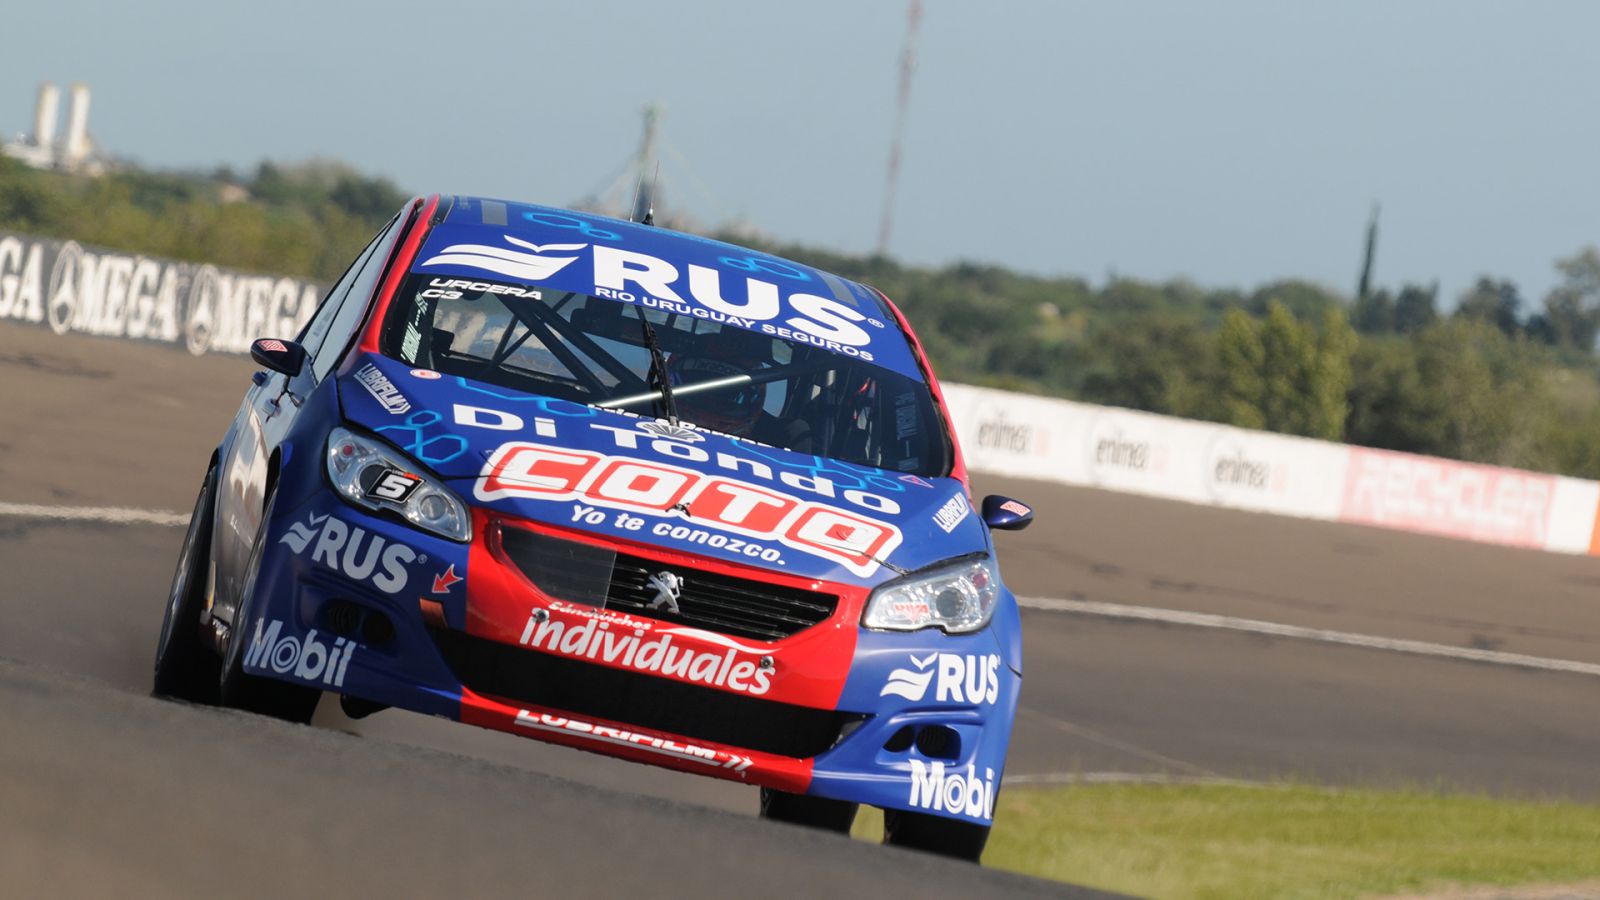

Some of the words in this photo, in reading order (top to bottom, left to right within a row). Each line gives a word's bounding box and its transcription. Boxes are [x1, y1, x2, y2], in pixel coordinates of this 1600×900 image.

[430, 278, 542, 300] URCERA
[593, 245, 871, 347] RUS
[595, 287, 635, 302] RIO
[642, 296, 755, 329] URUGUAY
[761, 324, 874, 361] SEGUROS
[453, 403, 556, 438] Di
[375, 474, 415, 499] 5
[482, 446, 896, 570] COTO
[312, 516, 417, 594] RUS
[571, 505, 605, 526] Yo
[614, 511, 645, 531] te
[652, 523, 786, 565] conozco.
[243, 618, 357, 687] Mobil
[936, 653, 999, 704] RUS
[908, 758, 995, 820] Mobi
